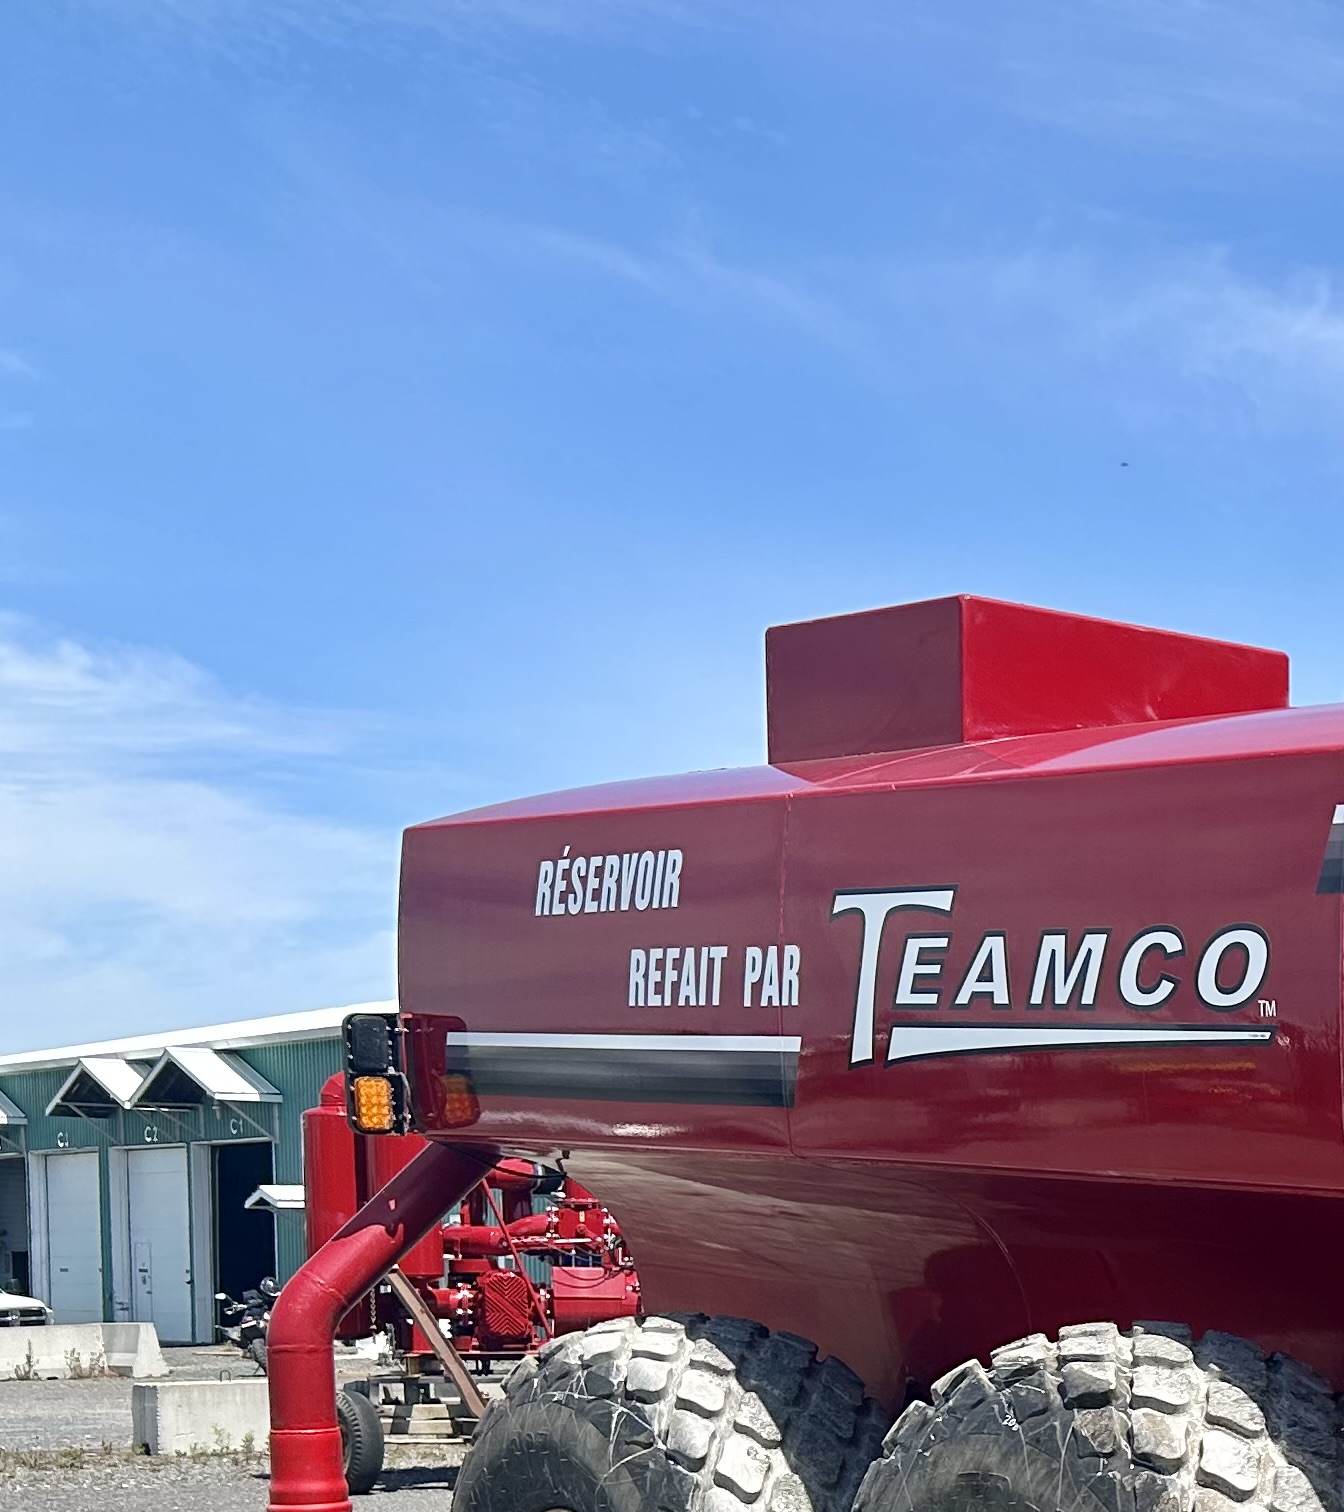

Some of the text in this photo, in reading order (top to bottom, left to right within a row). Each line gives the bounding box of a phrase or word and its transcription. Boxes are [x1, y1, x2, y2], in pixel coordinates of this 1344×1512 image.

[534, 845, 684, 917] RÉSERVOIR
[628, 944, 800, 1007] REFAIT PAR
[829, 884, 1271, 1069] TEAMCO
